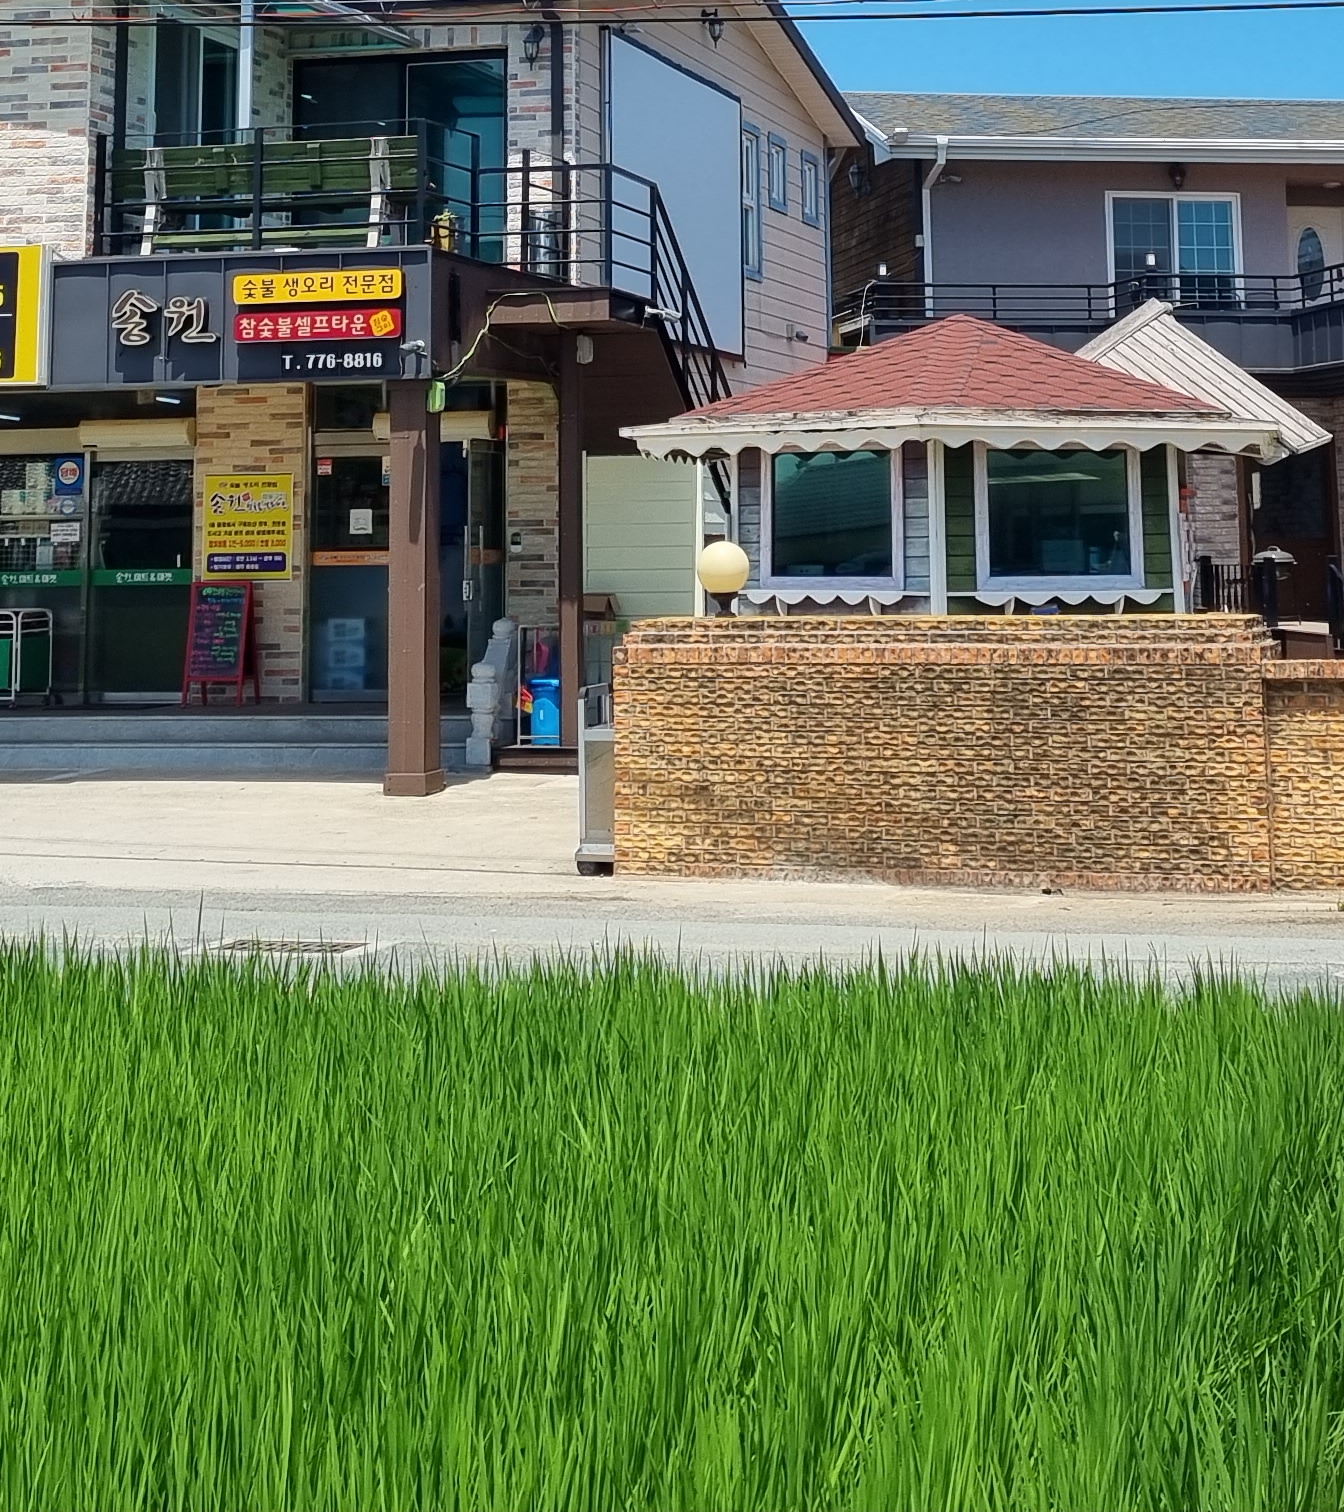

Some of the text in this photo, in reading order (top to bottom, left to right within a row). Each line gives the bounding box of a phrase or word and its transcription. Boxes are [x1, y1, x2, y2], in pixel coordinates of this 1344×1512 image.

[242, 274, 394, 299] 숯불 생오리 전문점
[112, 290, 216, 345] 송원
[239, 314, 367, 338] 참숯불셀프타운
